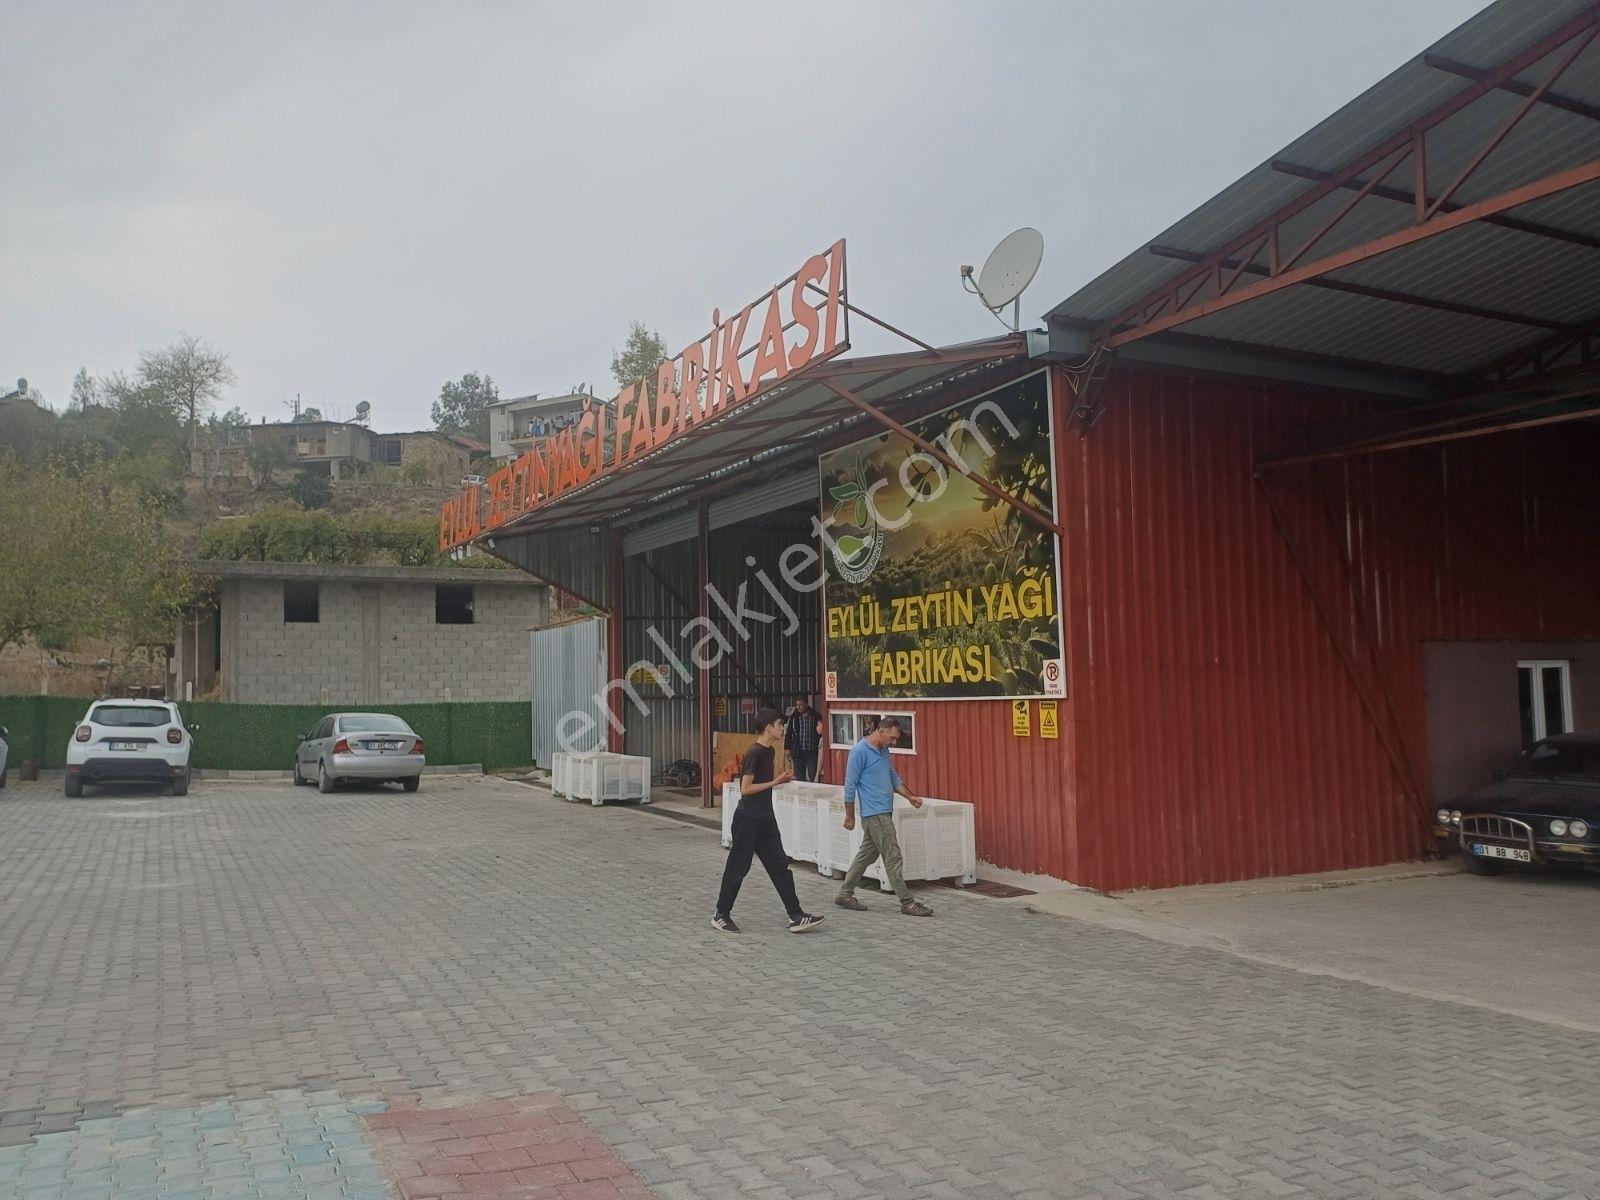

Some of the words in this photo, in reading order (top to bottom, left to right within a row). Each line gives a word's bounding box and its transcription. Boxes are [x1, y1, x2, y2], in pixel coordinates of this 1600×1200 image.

[615, 238, 846, 466] FABRİKASI
[828, 594, 886, 638] EYLÜL
[891, 580, 973, 632] ZEYTİN
[979, 566, 1053, 622] YAĞI
[870, 638, 992, 686] FABRİKASI
[1479, 845, 1489, 855] 01
[1496, 847, 1507, 857] BB
[1513, 850, 1529, 861] 948
